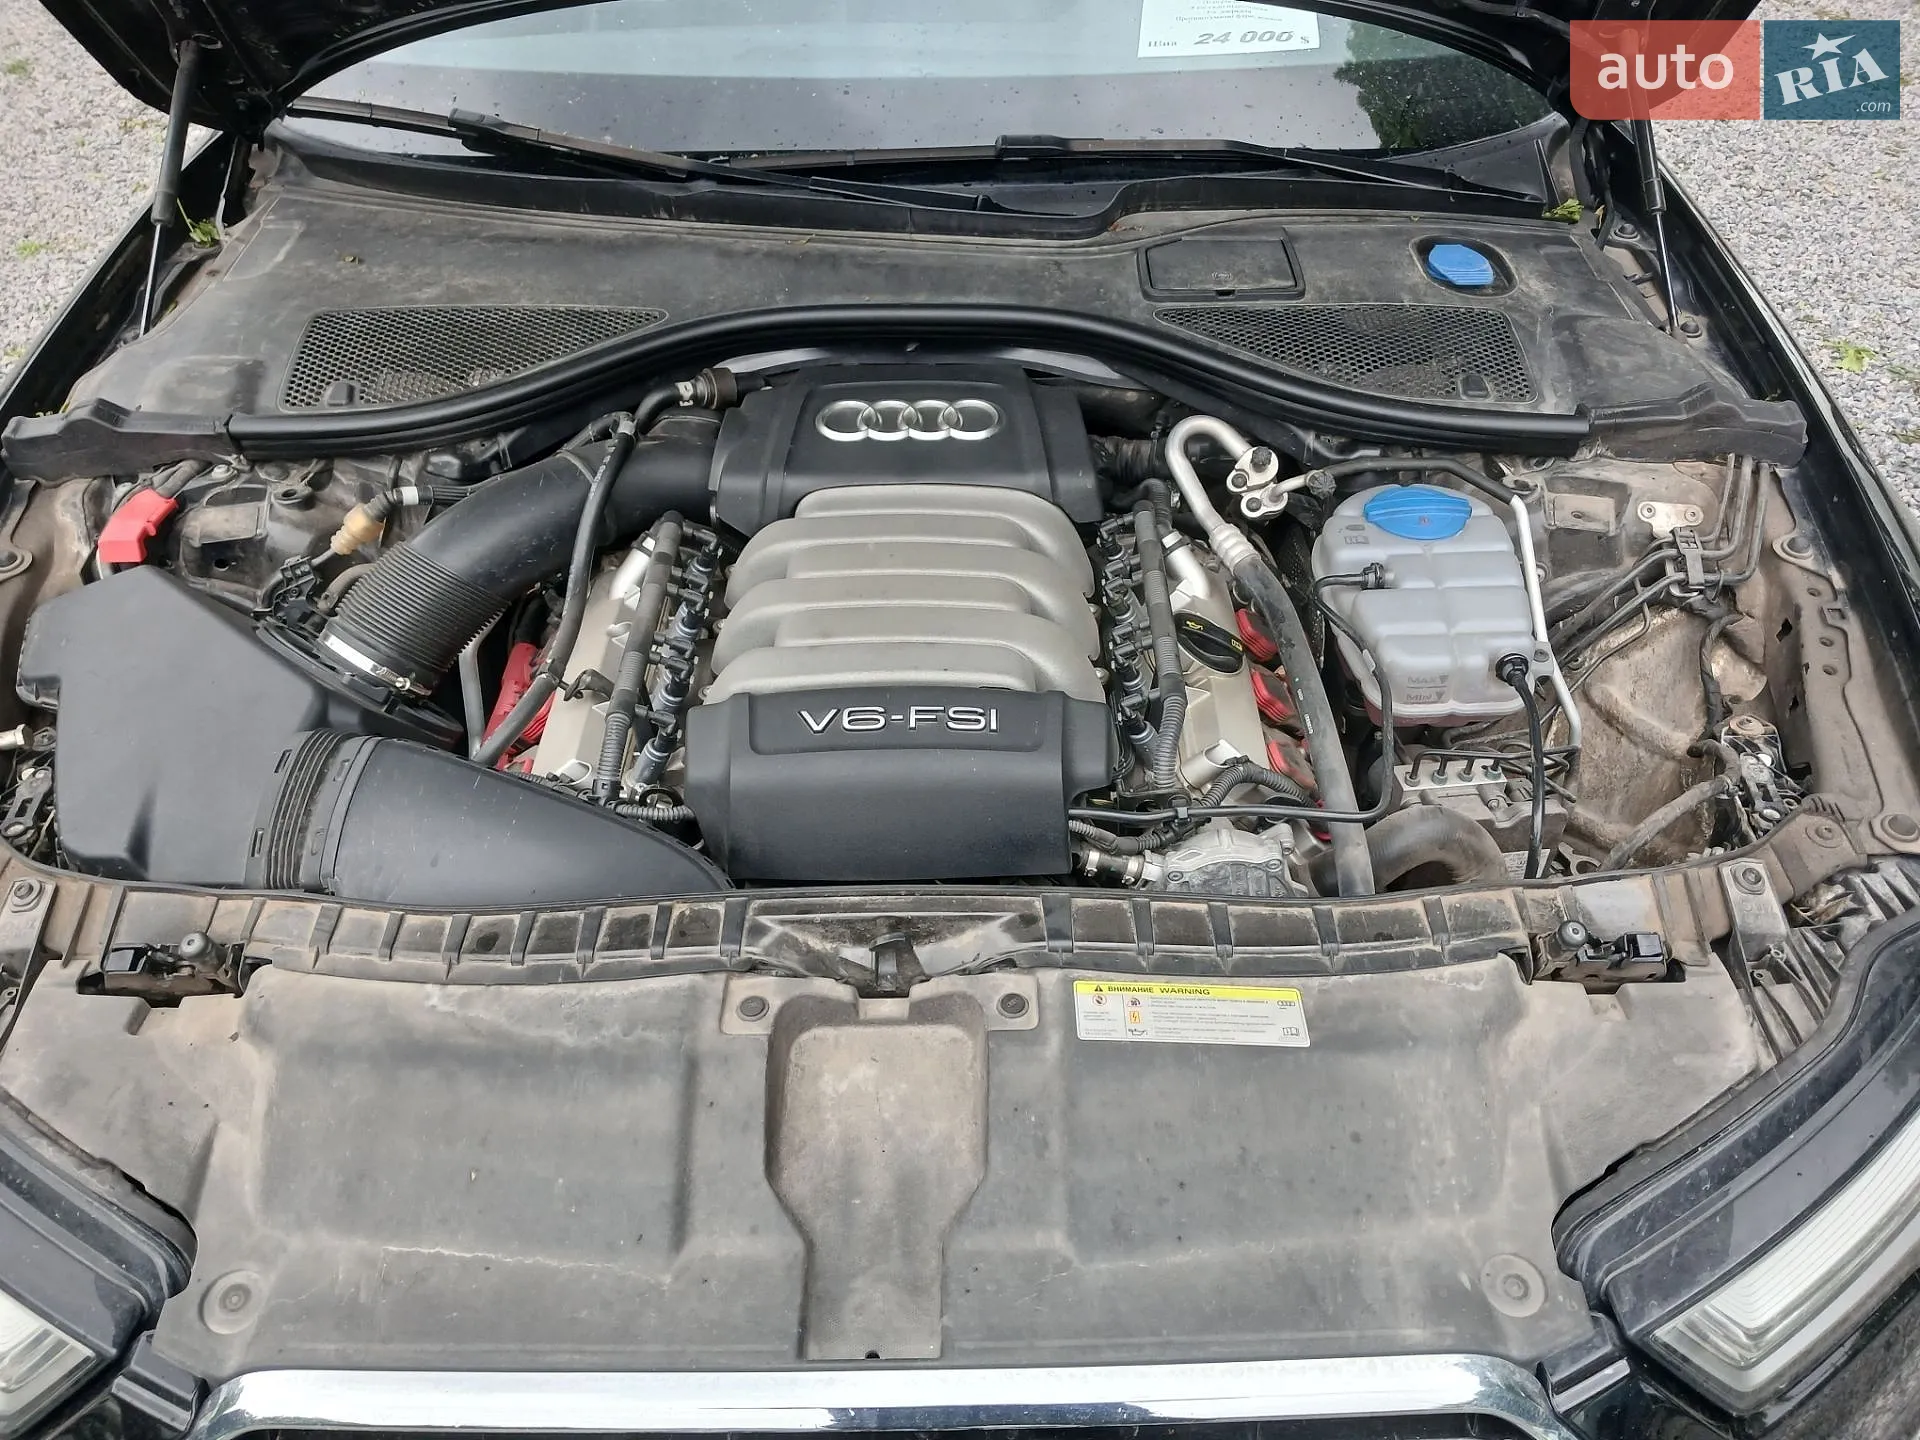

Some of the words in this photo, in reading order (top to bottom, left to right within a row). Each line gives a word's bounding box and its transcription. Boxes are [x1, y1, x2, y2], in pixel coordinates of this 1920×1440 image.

[1193, 32, 1232, 45] 24
[1240, 31, 1294, 43] 000
[798, 705, 999, 734] V6-FSI
[1107, 985, 1154, 994] ВНИМАНИЕ
[1159, 987, 1211, 996] WARNING
